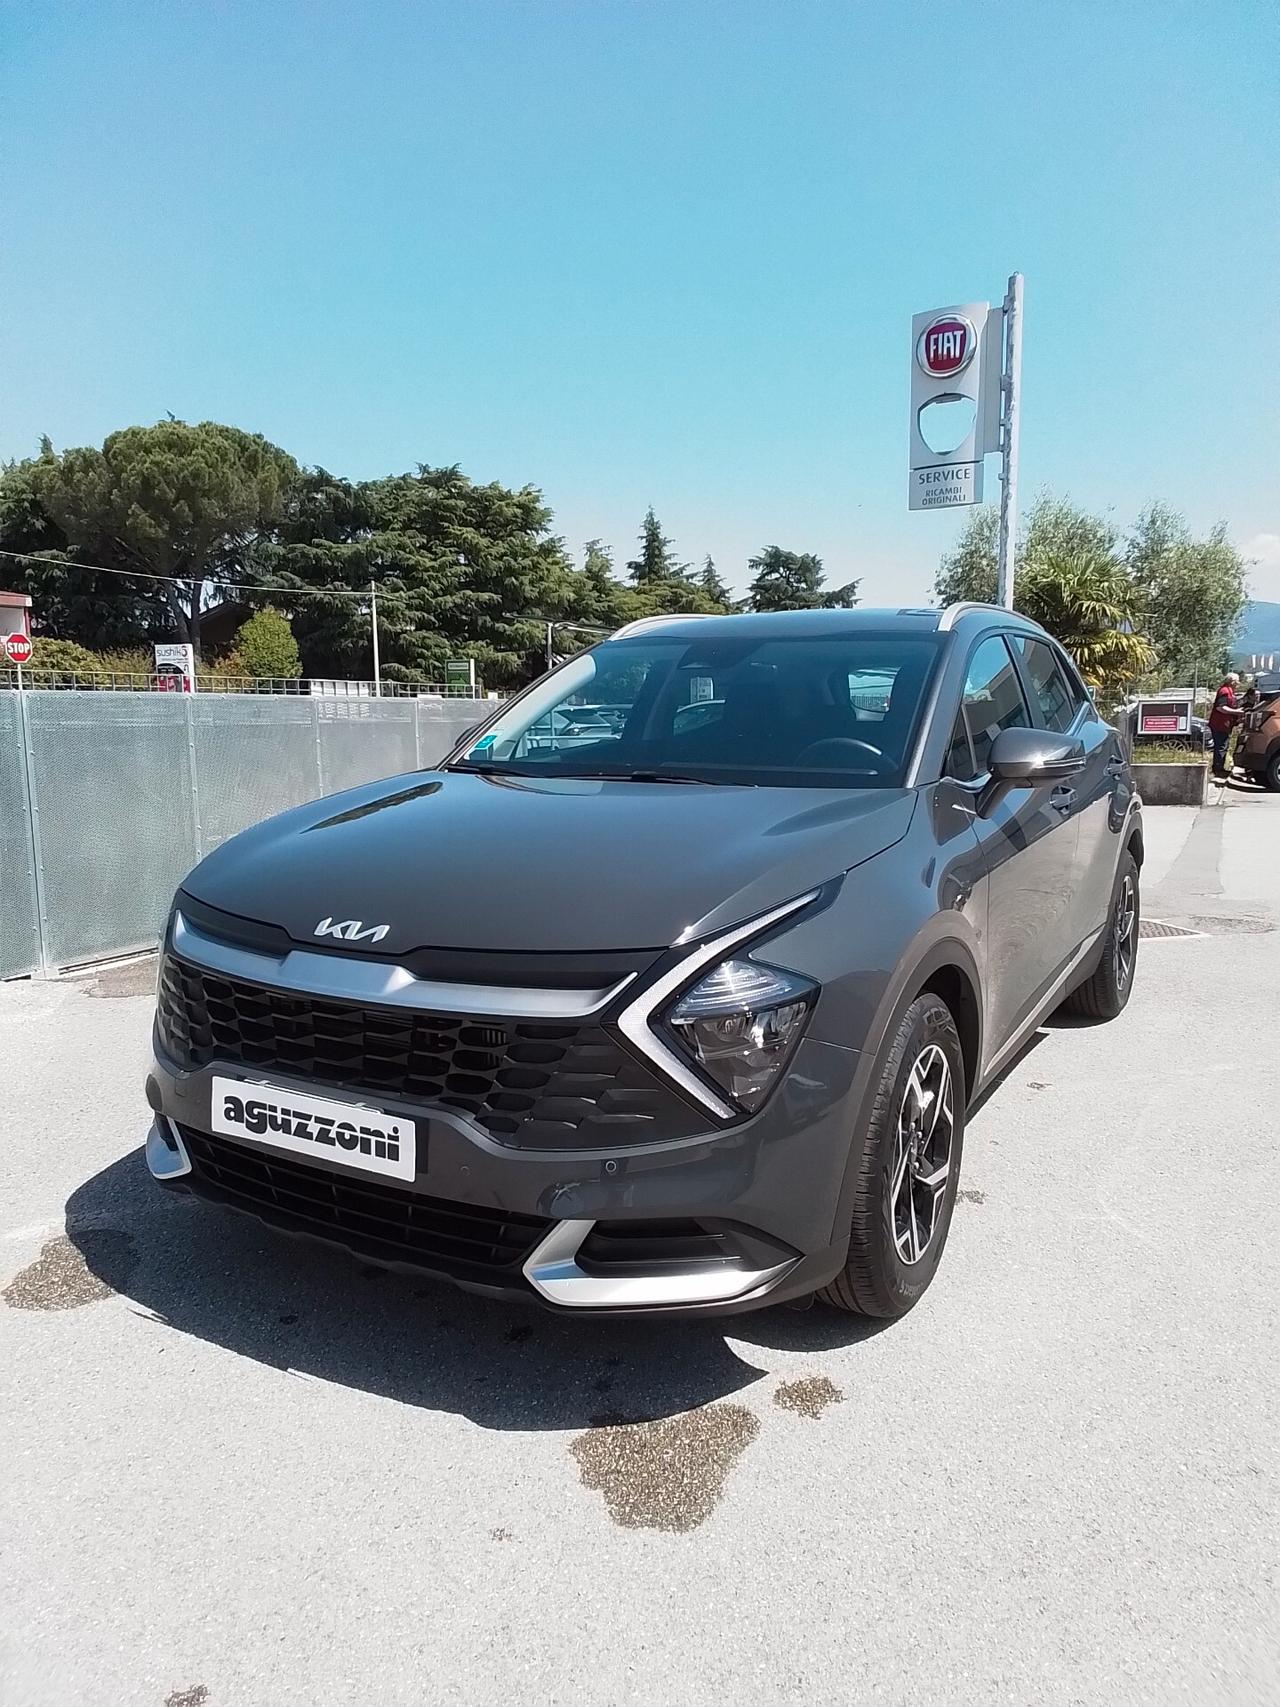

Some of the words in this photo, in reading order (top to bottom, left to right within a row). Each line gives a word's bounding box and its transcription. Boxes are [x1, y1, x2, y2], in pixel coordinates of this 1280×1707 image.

[929, 329, 964, 362] FIAT
[918, 468, 970, 485] SERVICE
[925, 486, 962, 497] RICAMBI
[921, 494, 966, 506] ORIGINALI
[7, 642, 30, 654] STOP
[223, 1095, 400, 1162] aguzzoni
